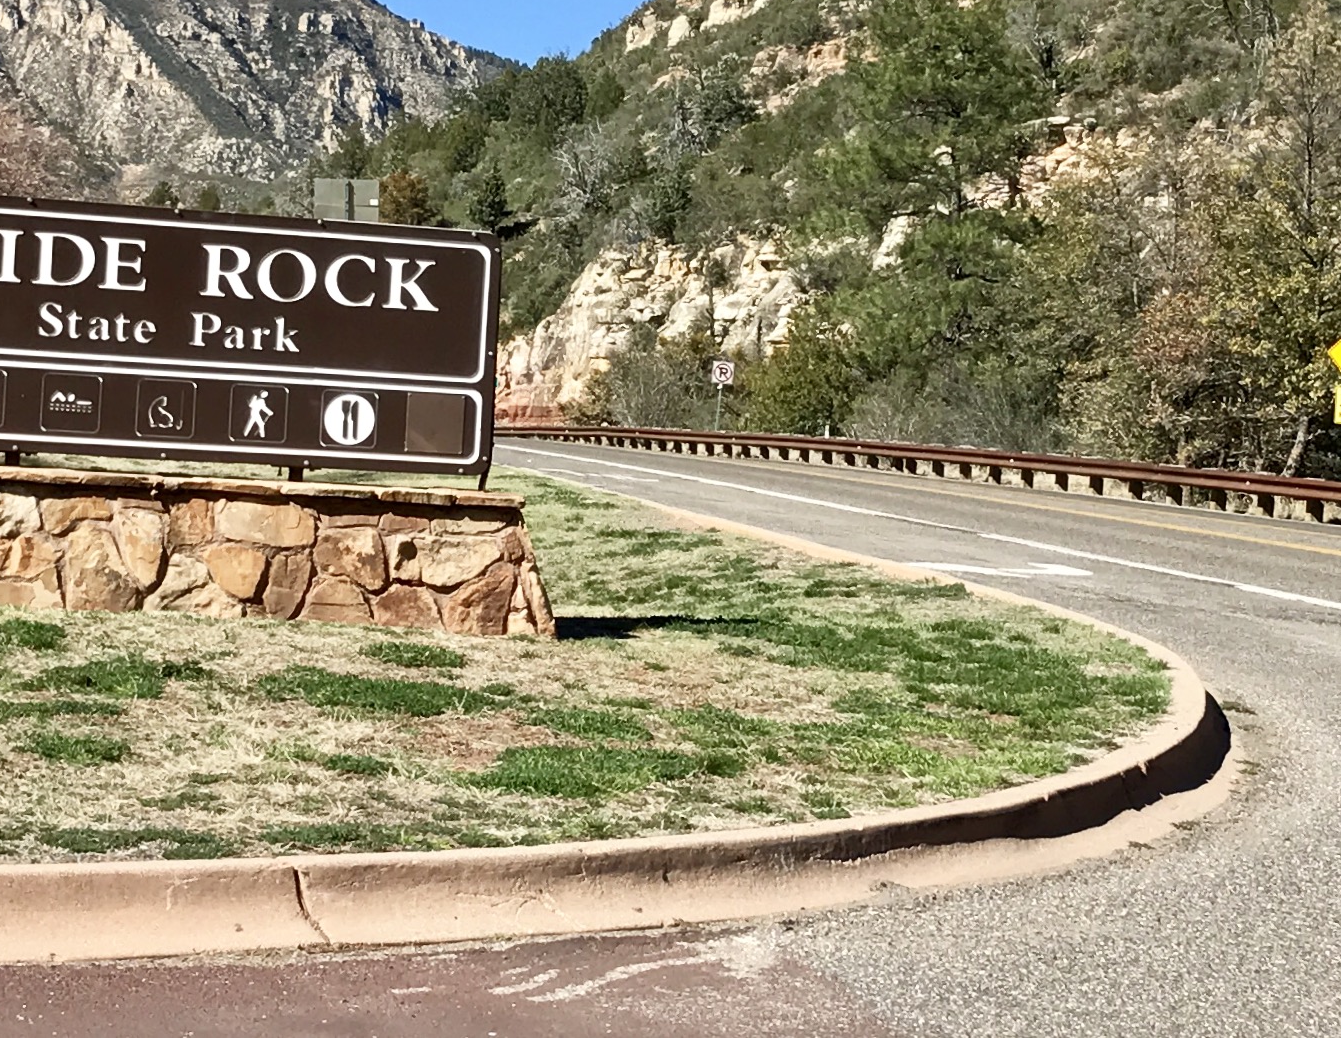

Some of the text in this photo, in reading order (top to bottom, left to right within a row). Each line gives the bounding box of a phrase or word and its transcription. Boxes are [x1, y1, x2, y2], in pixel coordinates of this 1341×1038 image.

[200, 244, 440, 312] ROCK
[38, 301, 300, 353] State Park
